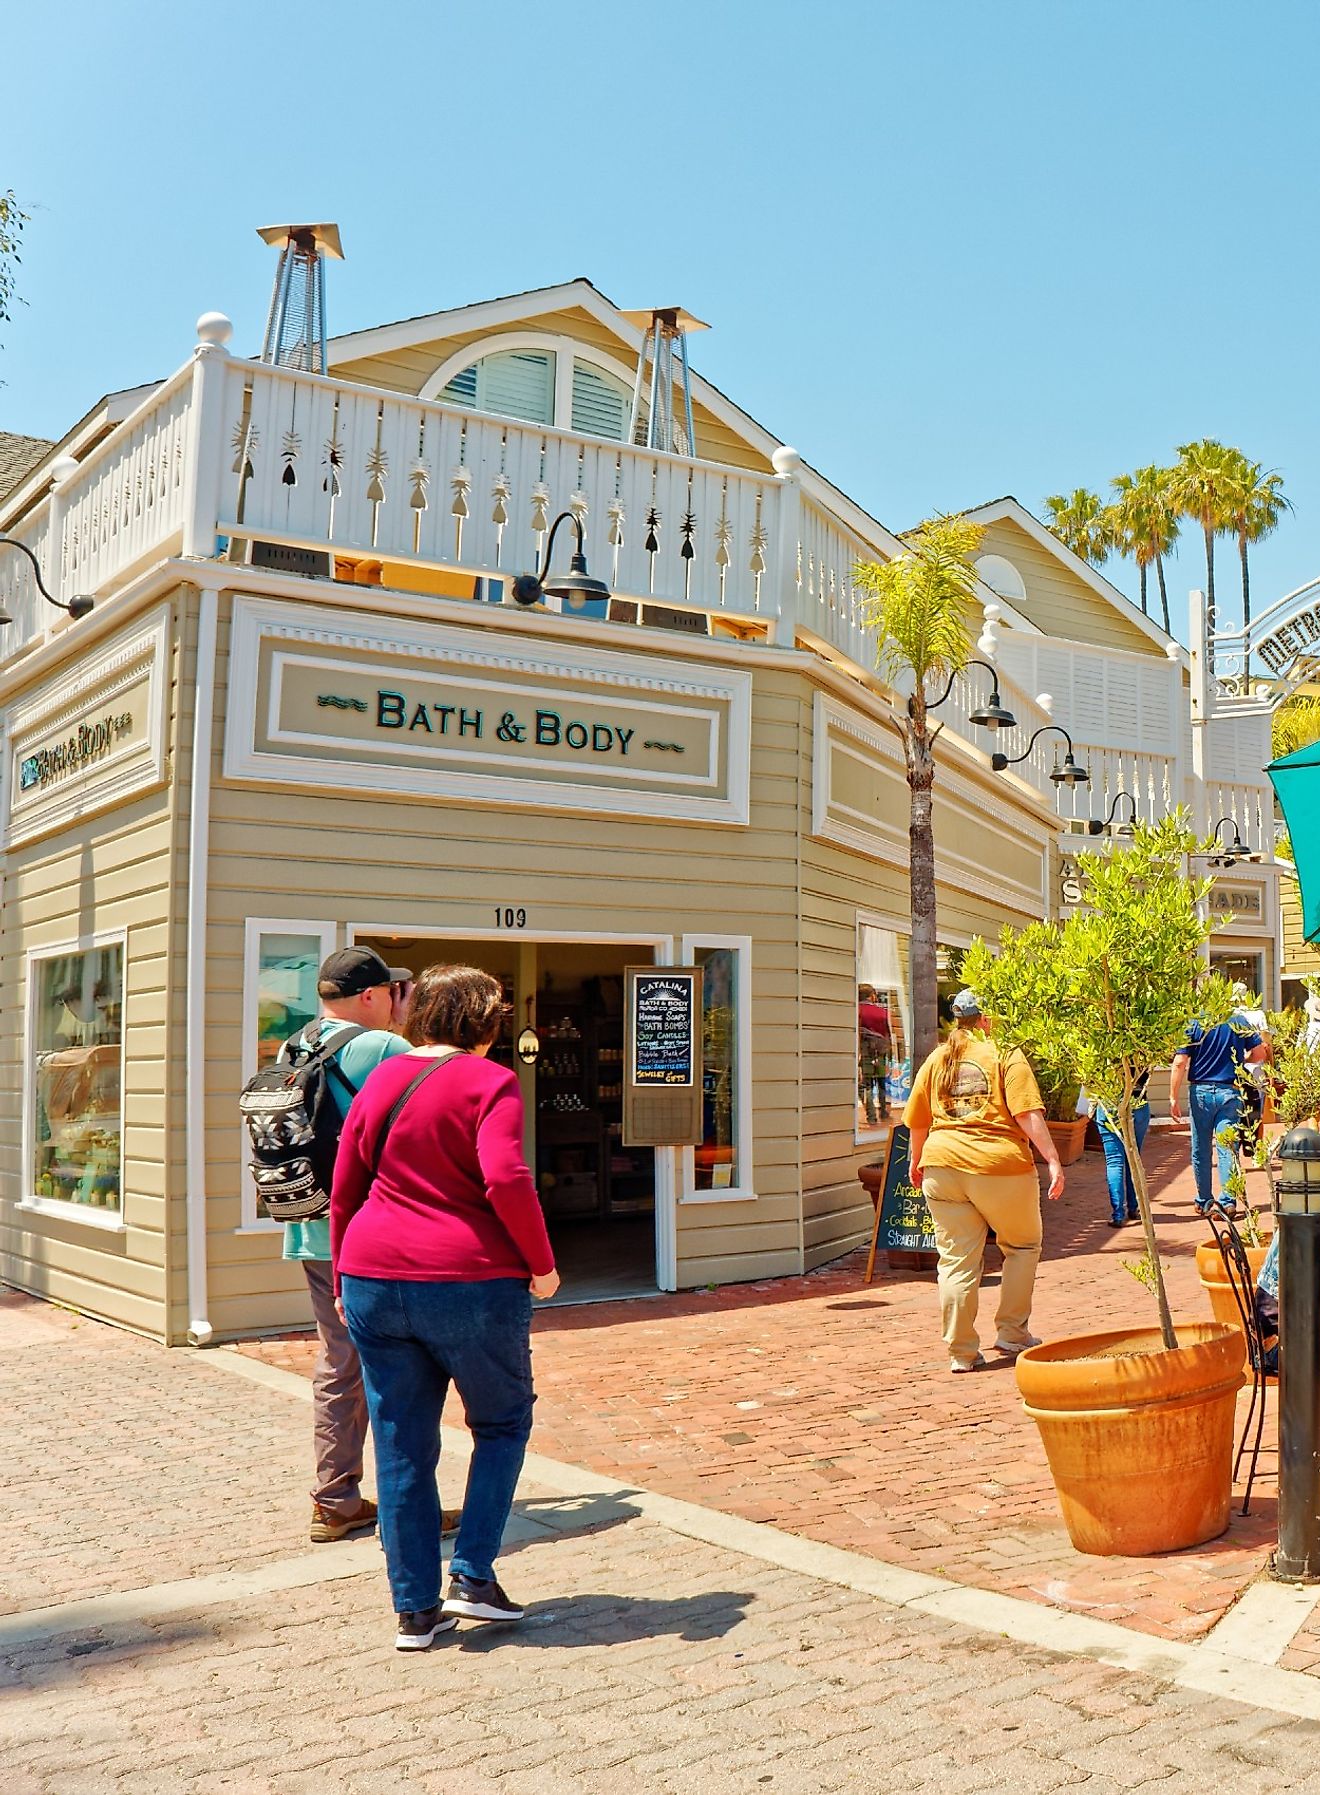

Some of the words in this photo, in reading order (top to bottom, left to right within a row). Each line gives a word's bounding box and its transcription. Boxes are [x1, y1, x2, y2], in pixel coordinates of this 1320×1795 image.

[377, 690, 483, 738] BATH
[496, 710, 527, 743] &
[536, 709, 635, 755] BODY
[494, 907, 527, 930] 109
[640, 981, 688, 996] CATALINA
[644, 1022, 662, 1030] BATH
[903, 1199, 920, 1215] Bar
